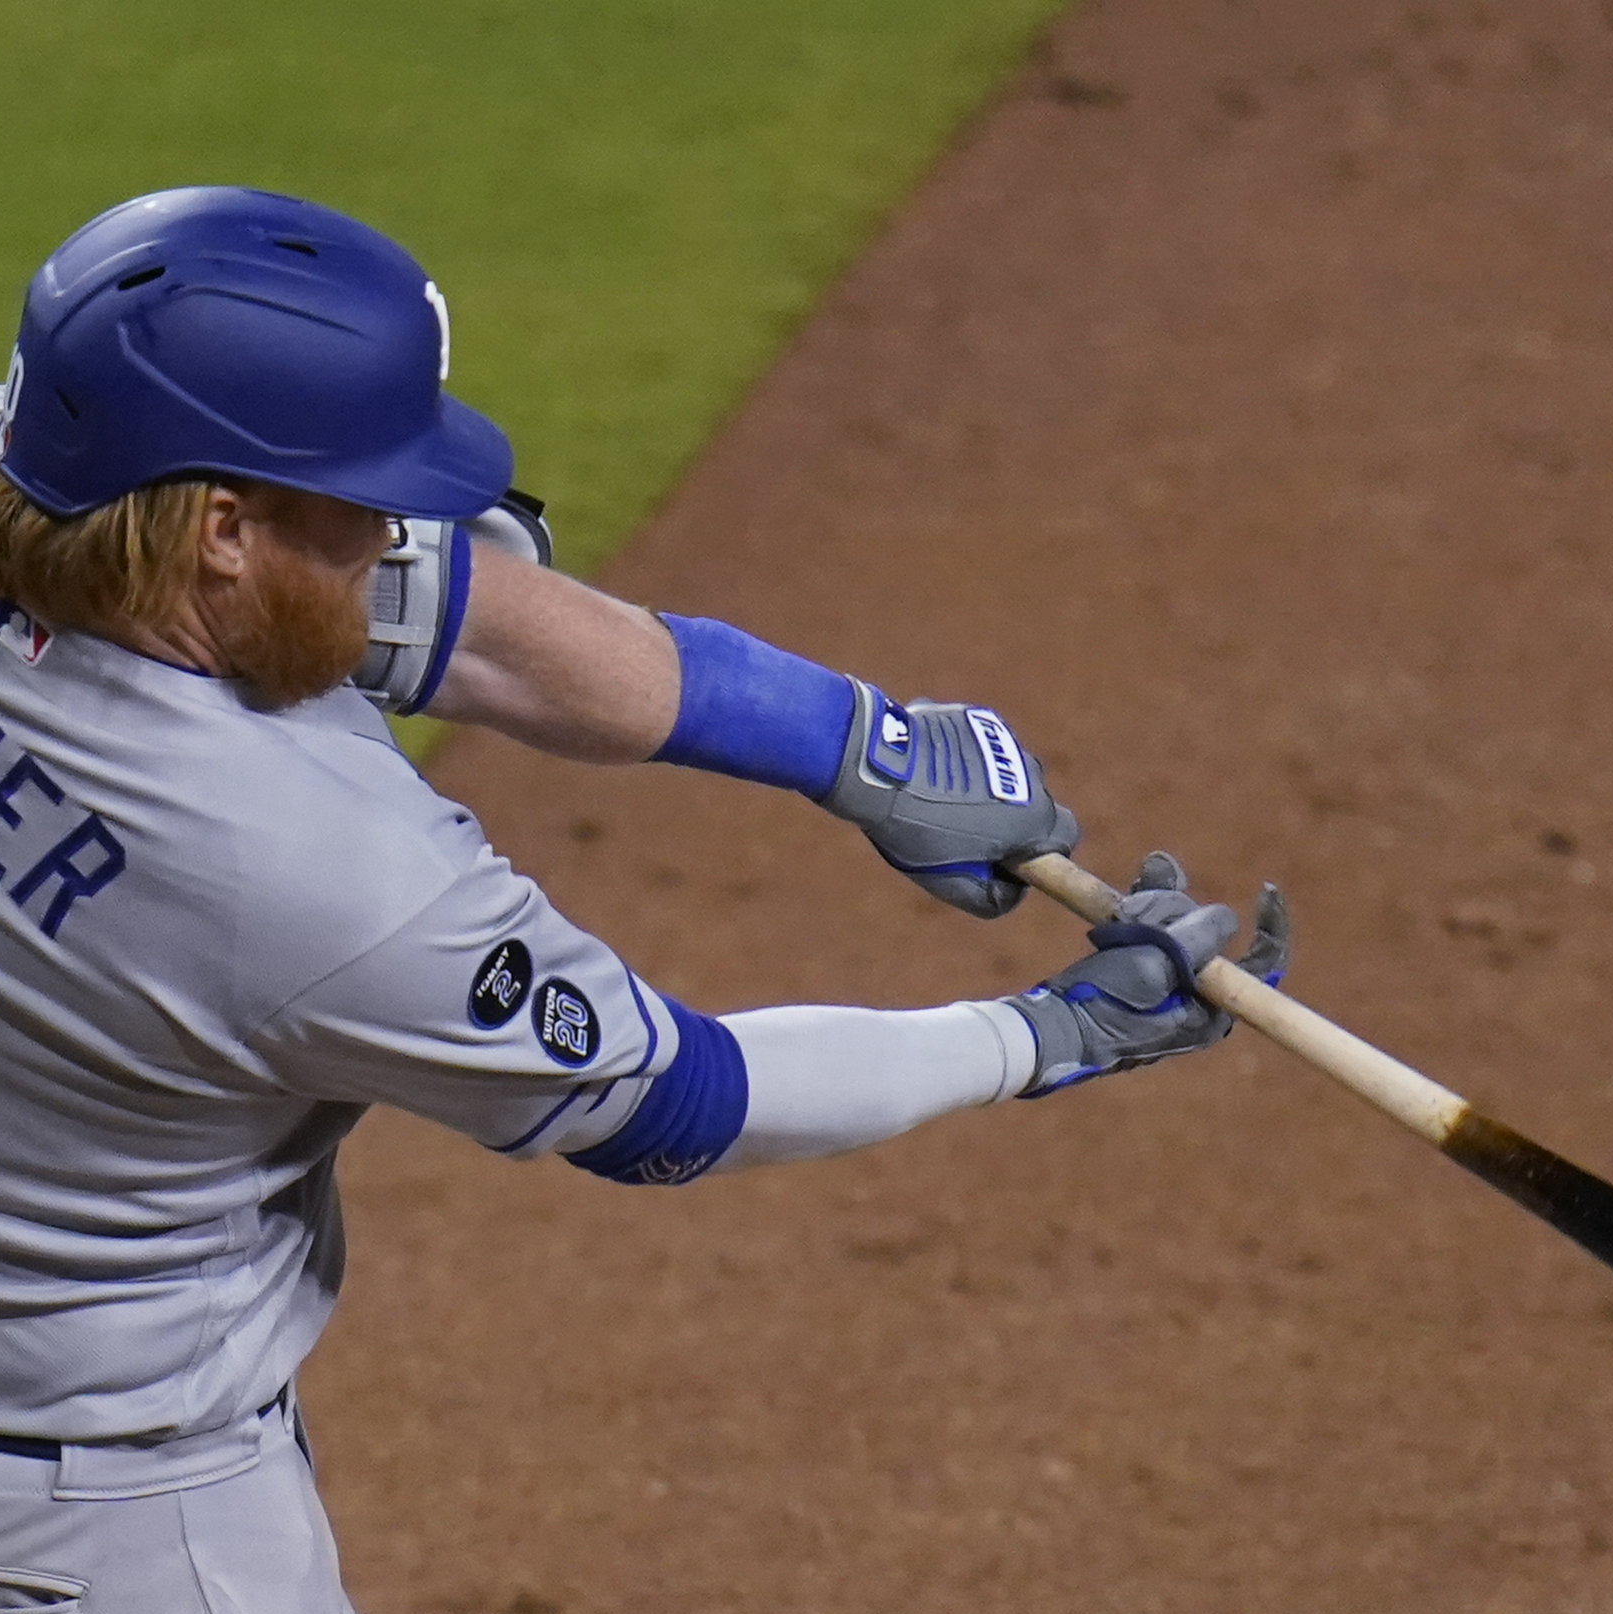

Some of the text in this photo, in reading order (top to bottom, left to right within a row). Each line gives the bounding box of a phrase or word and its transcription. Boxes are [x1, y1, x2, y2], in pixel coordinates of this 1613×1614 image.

[475, 946, 509, 998] TOMMY
[491, 969, 522, 1008] 2
[542, 985, 556, 1043] SUTTON
[554, 992, 588, 1056] 20
